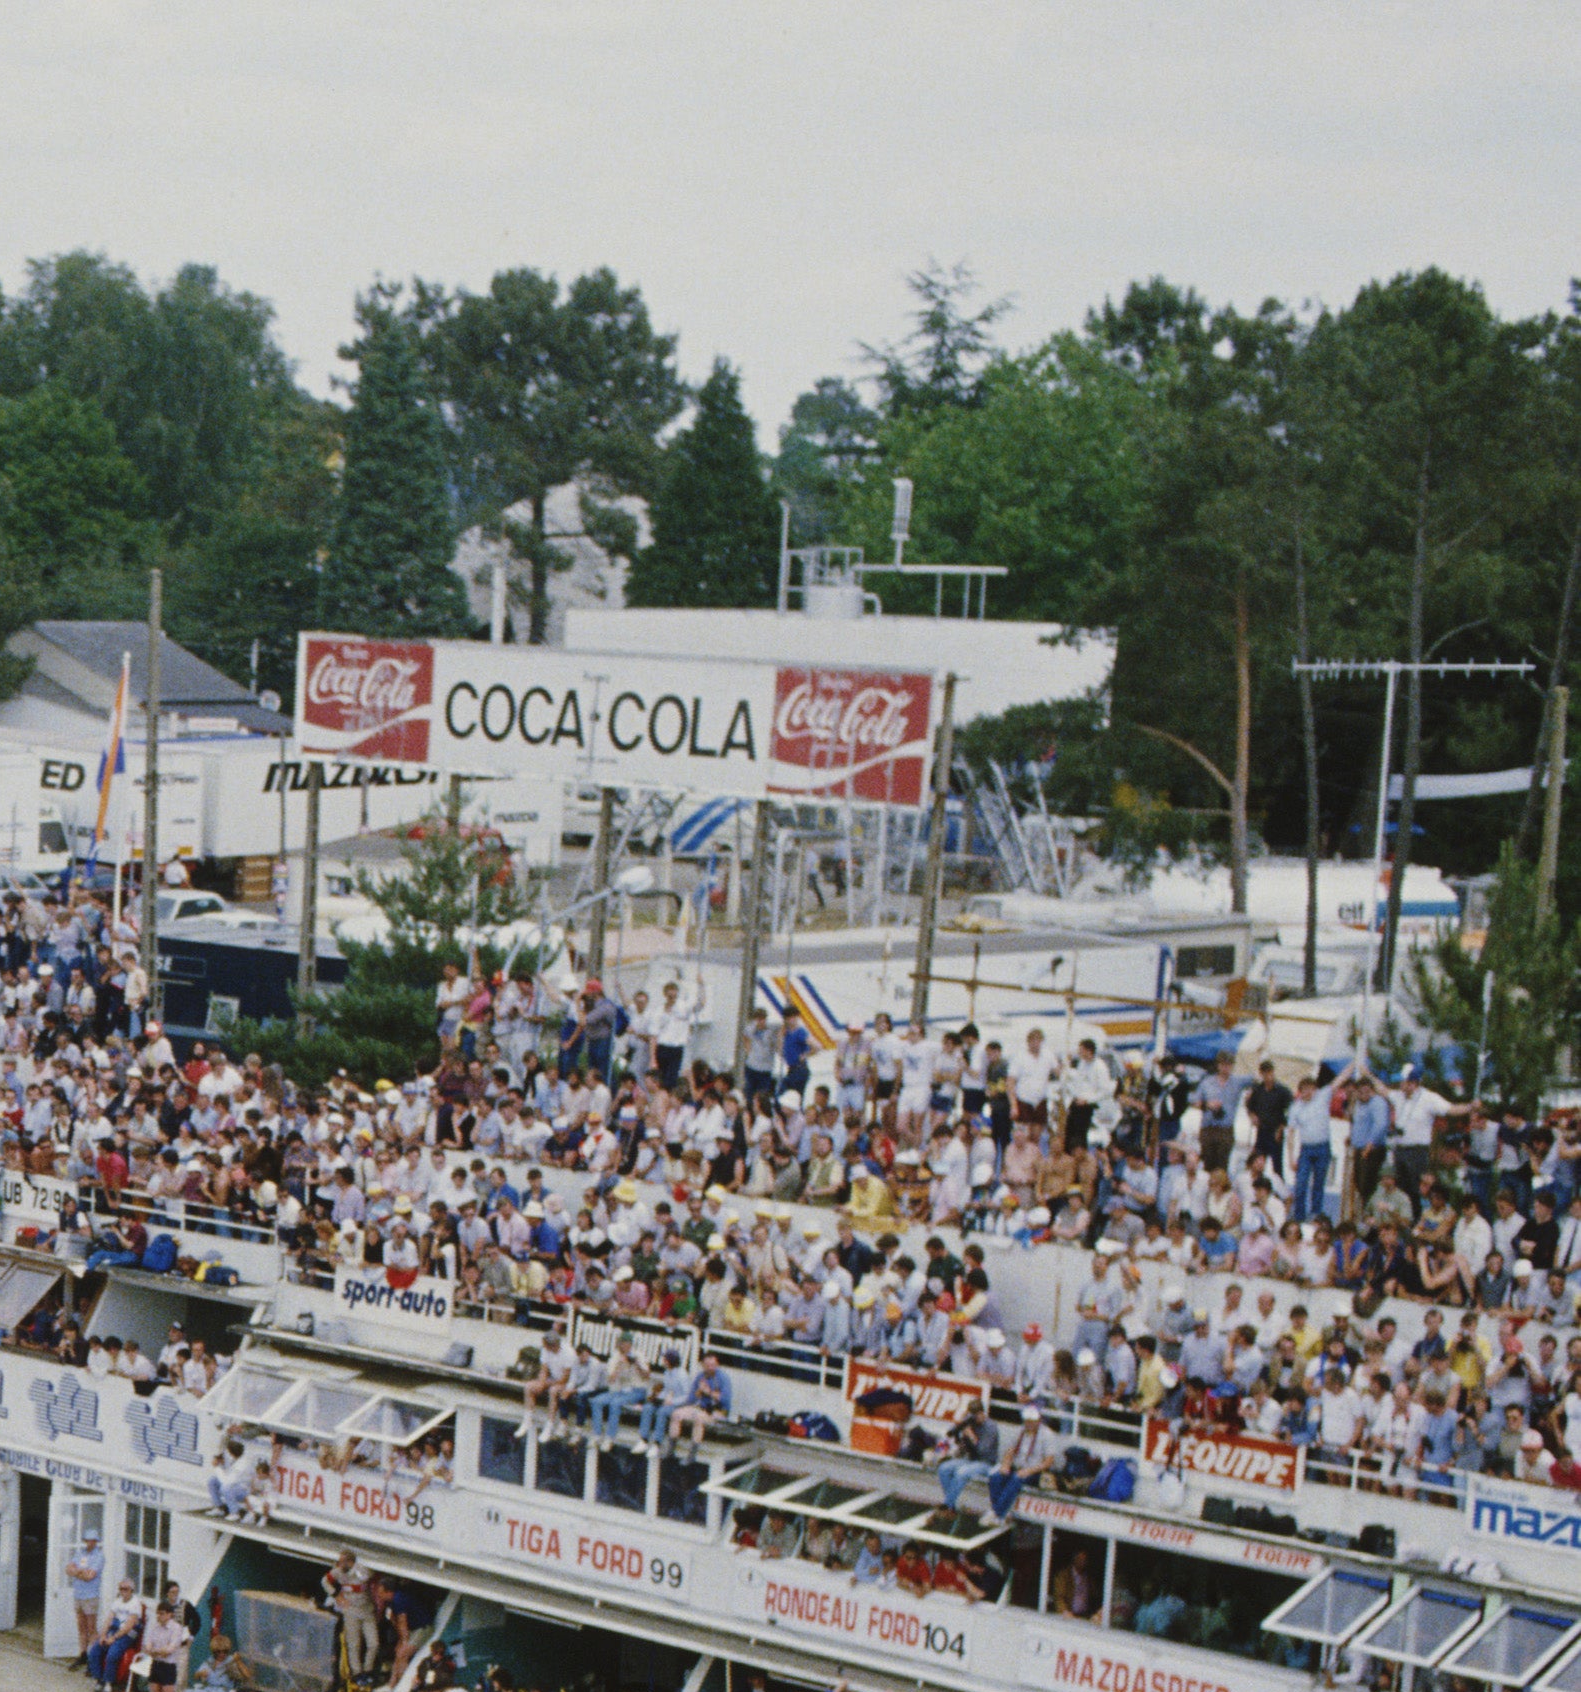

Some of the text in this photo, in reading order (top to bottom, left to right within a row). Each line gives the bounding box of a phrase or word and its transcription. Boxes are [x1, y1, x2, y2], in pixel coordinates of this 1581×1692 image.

[342, 1279, 447, 1318] sport-auto
[276, 1465, 435, 1531] TIGA FORD 98
[507, 1517, 684, 1589] TIGA FORD 99
[764, 1582, 966, 1660] RONDEAU FORD 104
